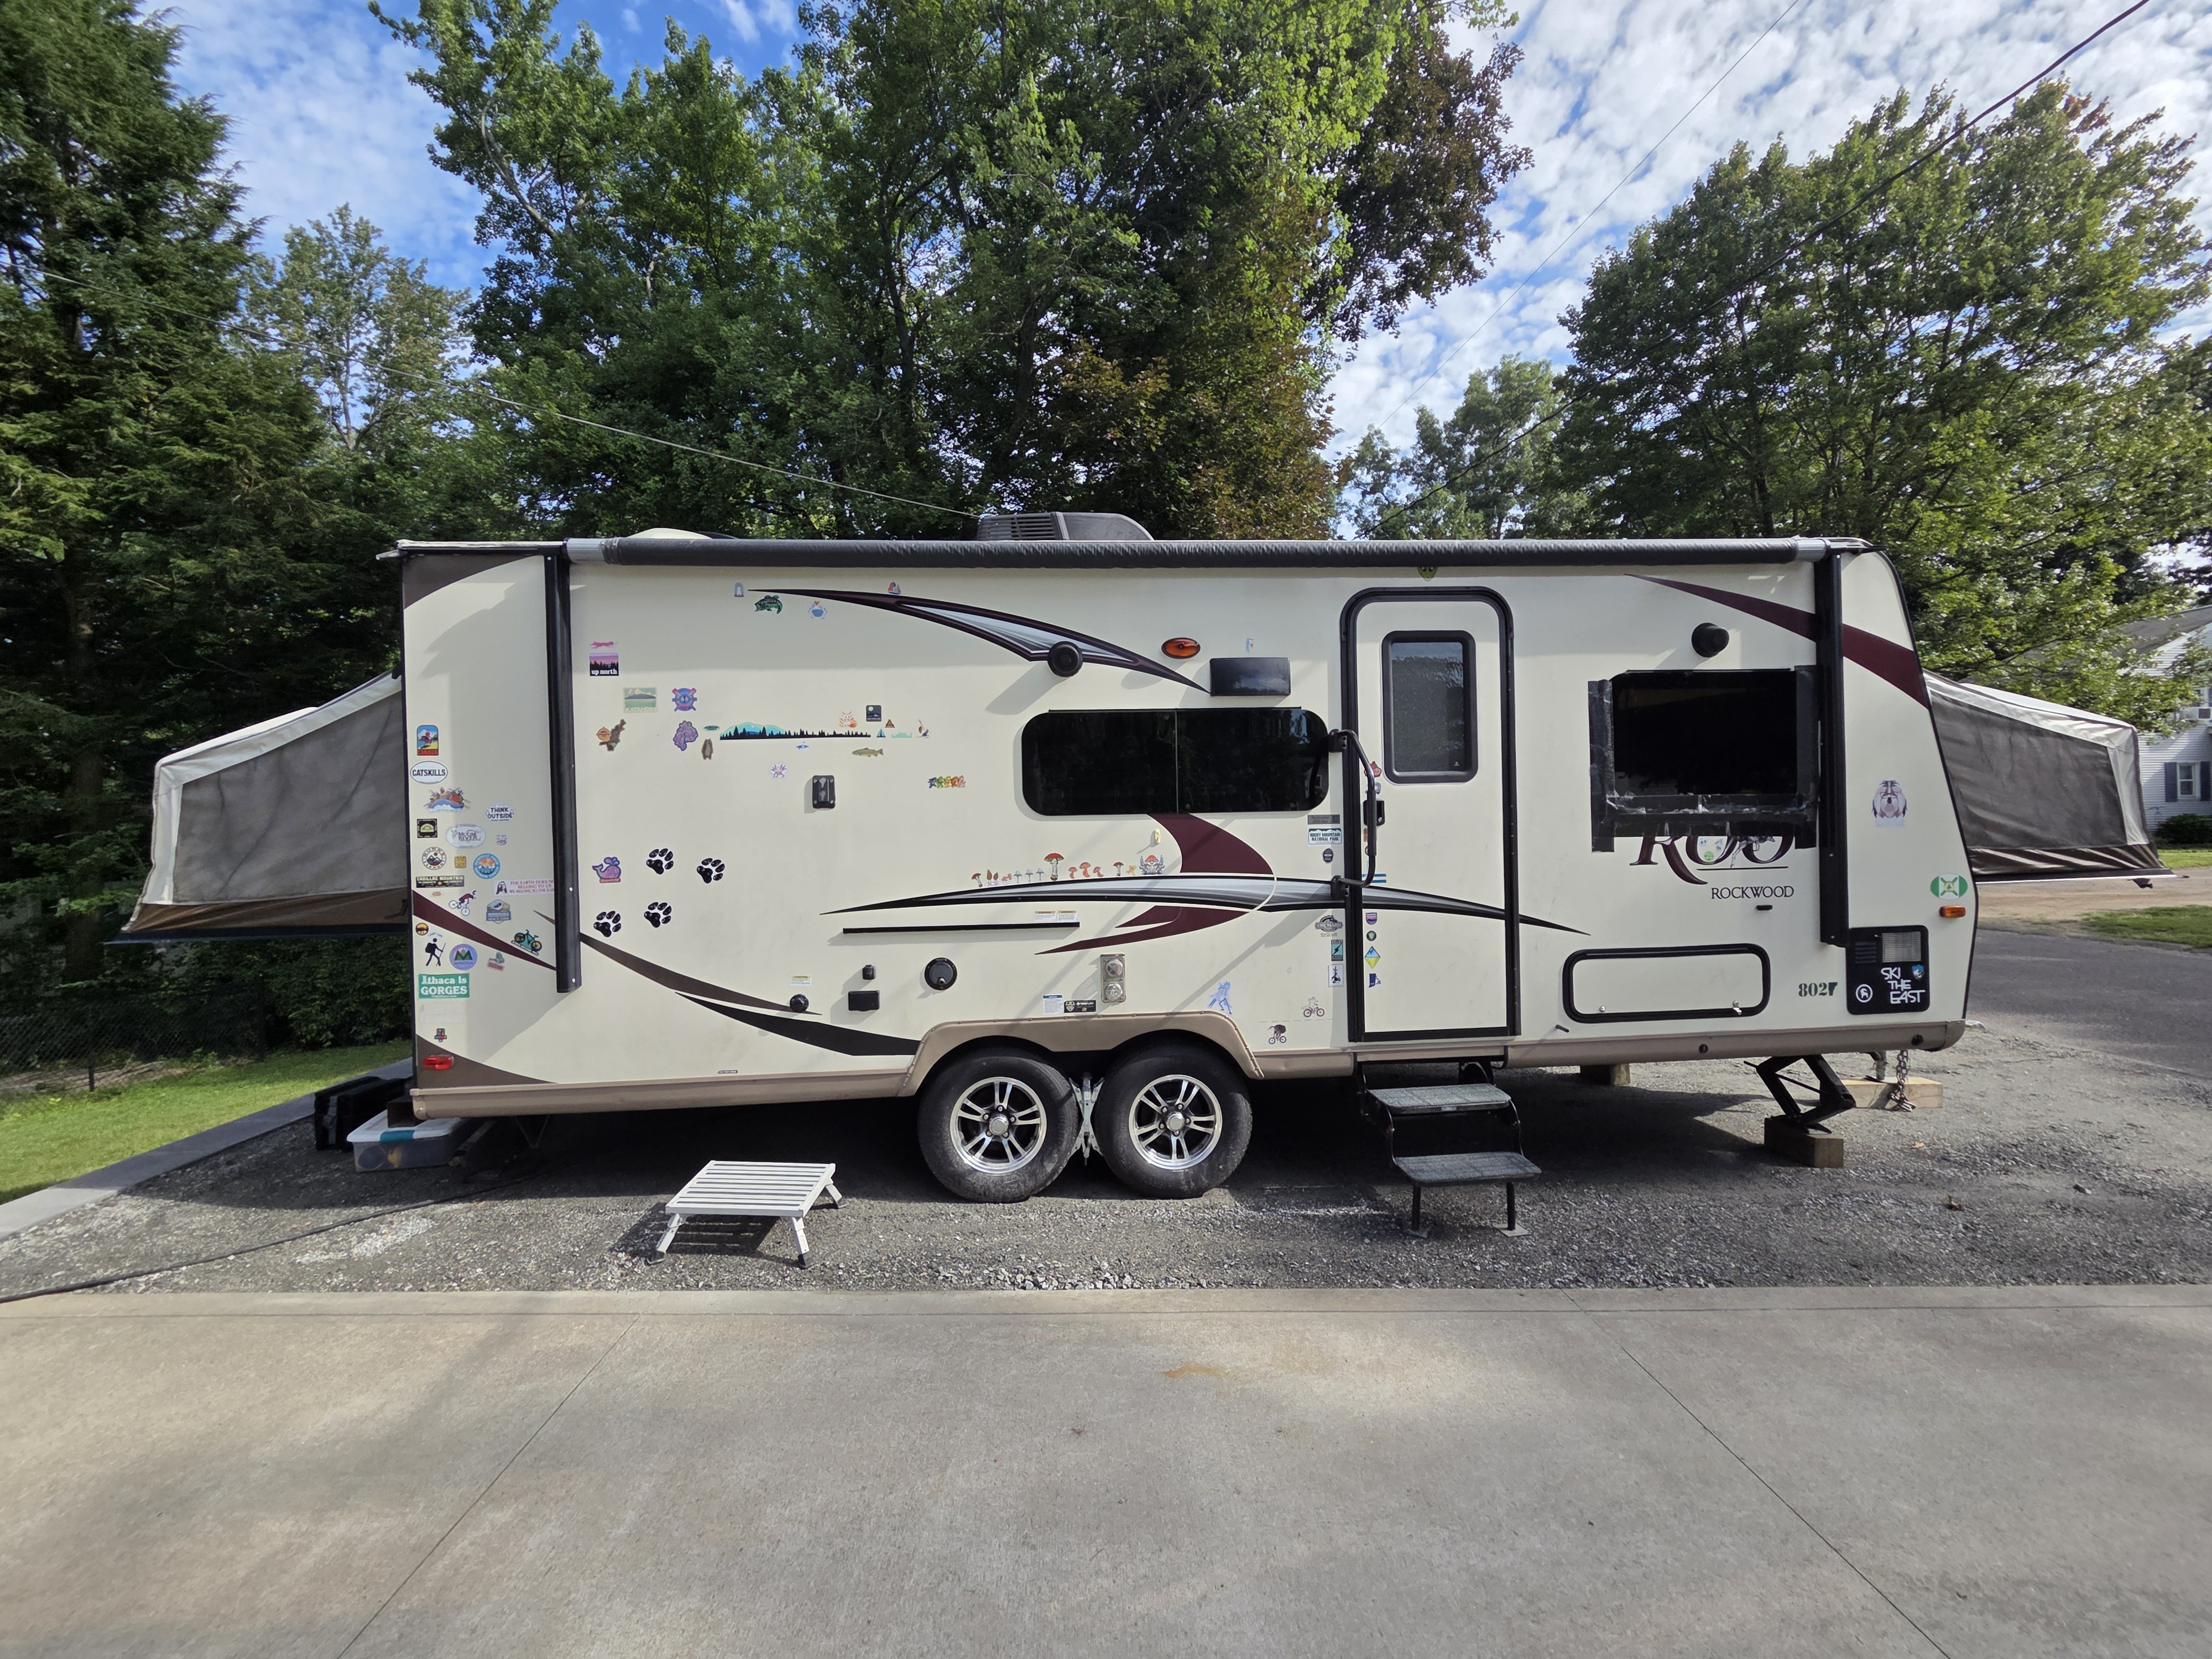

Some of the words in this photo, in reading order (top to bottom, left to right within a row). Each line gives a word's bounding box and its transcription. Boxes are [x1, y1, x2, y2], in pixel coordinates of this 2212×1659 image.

[1711, 886, 1794, 899] ROCKWOOD
[421, 975, 455, 984] Ithaca
[1881, 967, 1901, 980] SKI
[421, 985, 467, 995] GORGES
[1887, 979, 1911, 991] THE
[1890, 990, 1926, 1004] EAST
